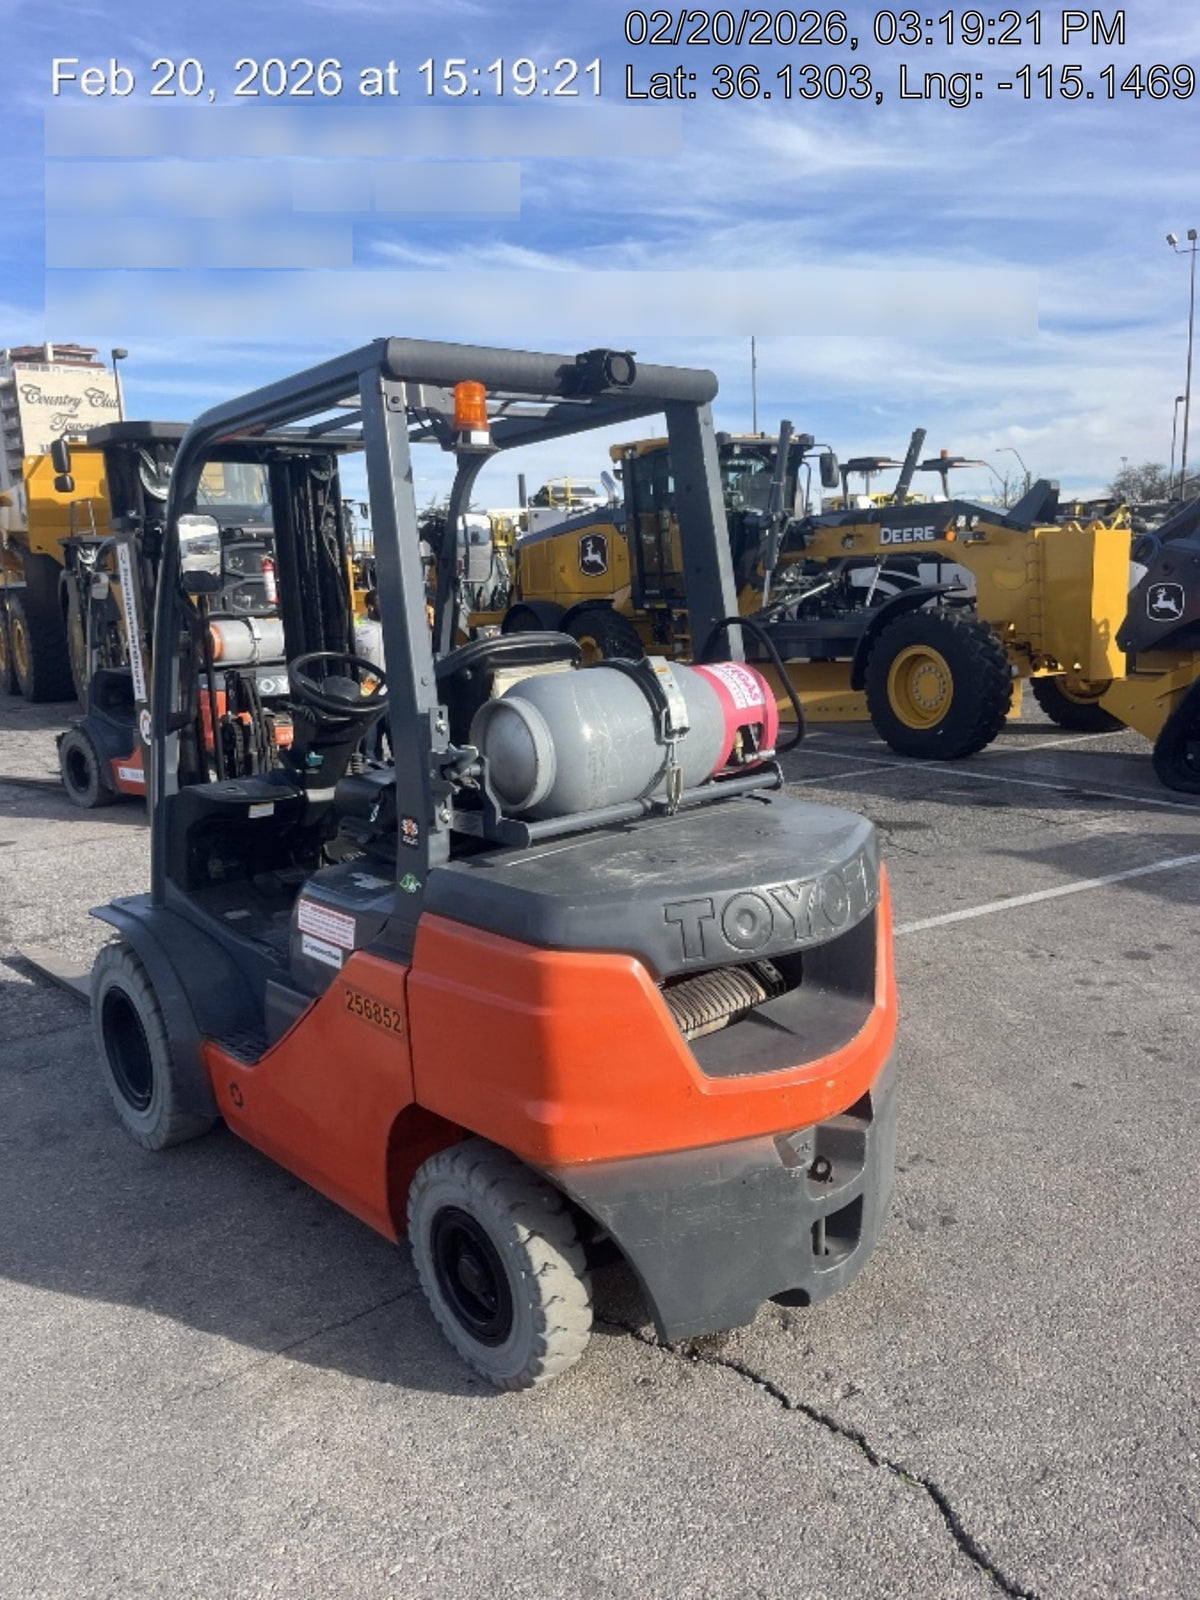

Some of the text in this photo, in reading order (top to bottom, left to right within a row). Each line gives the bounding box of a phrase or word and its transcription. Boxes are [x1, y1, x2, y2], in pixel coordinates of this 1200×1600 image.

[20, 383, 82, 413] Country
[880, 525, 937, 545] DEERE
[345, 989, 403, 1034] 256852
